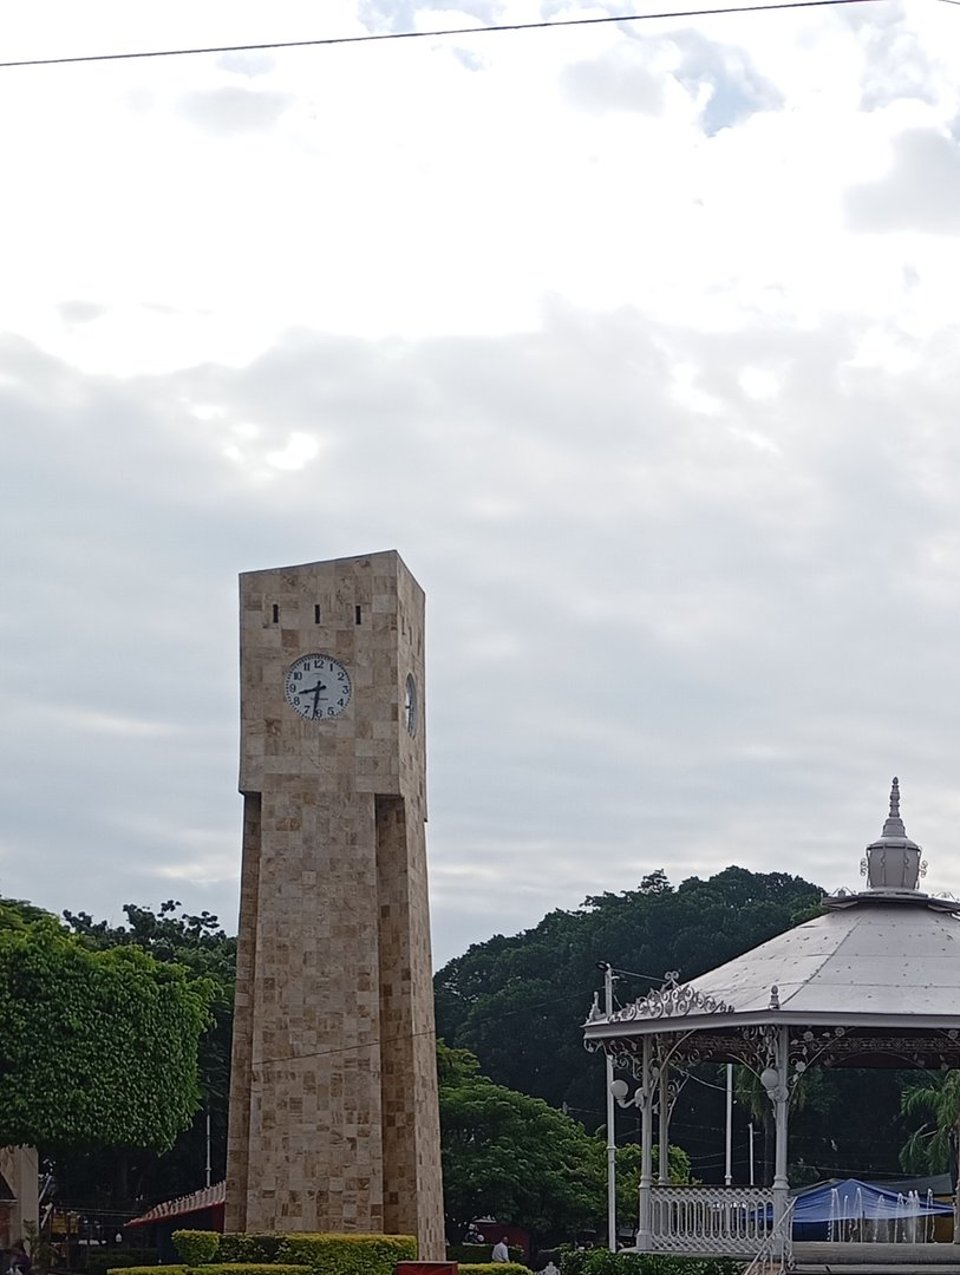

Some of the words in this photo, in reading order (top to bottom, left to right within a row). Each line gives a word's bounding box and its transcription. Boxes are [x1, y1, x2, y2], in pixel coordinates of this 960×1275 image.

[304, 662, 310, 671] 11
[314, 660, 324, 669] 12
[330, 663, 334, 671] 1
[294, 672, 302, 680] 10
[337, 672, 345, 681] 2
[289, 684, 296, 693] 9
[342, 686, 349, 695] 3
[293, 697, 300, 706] 8
[337, 698, 344, 706] 4
[304, 705, 310, 714] 7
[327, 707, 335, 716] 5
